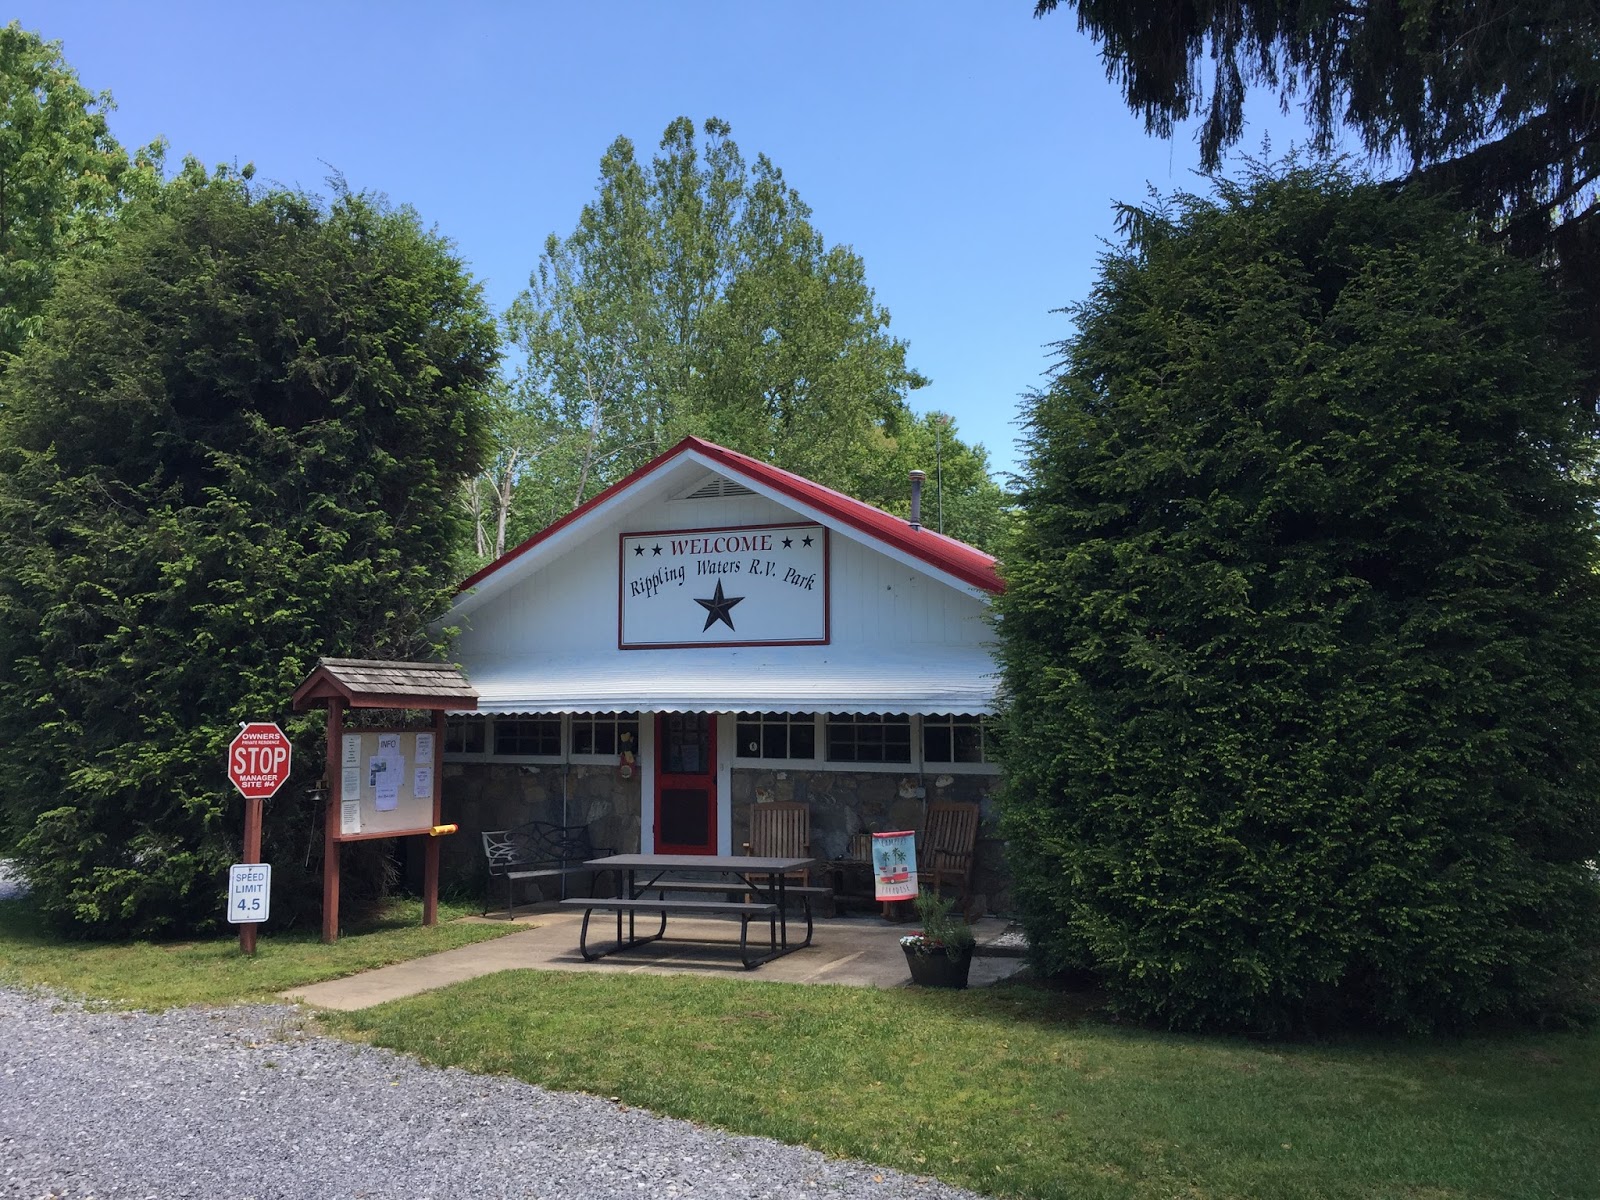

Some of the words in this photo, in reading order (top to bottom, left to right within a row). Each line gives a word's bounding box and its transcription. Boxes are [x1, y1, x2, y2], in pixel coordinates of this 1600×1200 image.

[671, 534, 773, 556] WELCOME
[630, 565, 685, 598] Rippling
[697, 559, 741, 576] Waters
[748, 558, 776, 577] R.V.
[783, 566, 815, 590] Park
[381, 740, 396, 748] INFO
[234, 747, 286, 774] STOP
[235, 873, 264, 882] SPEED
[235, 885, 263, 894] LIMIT
[237, 898, 260, 911] 4.5
